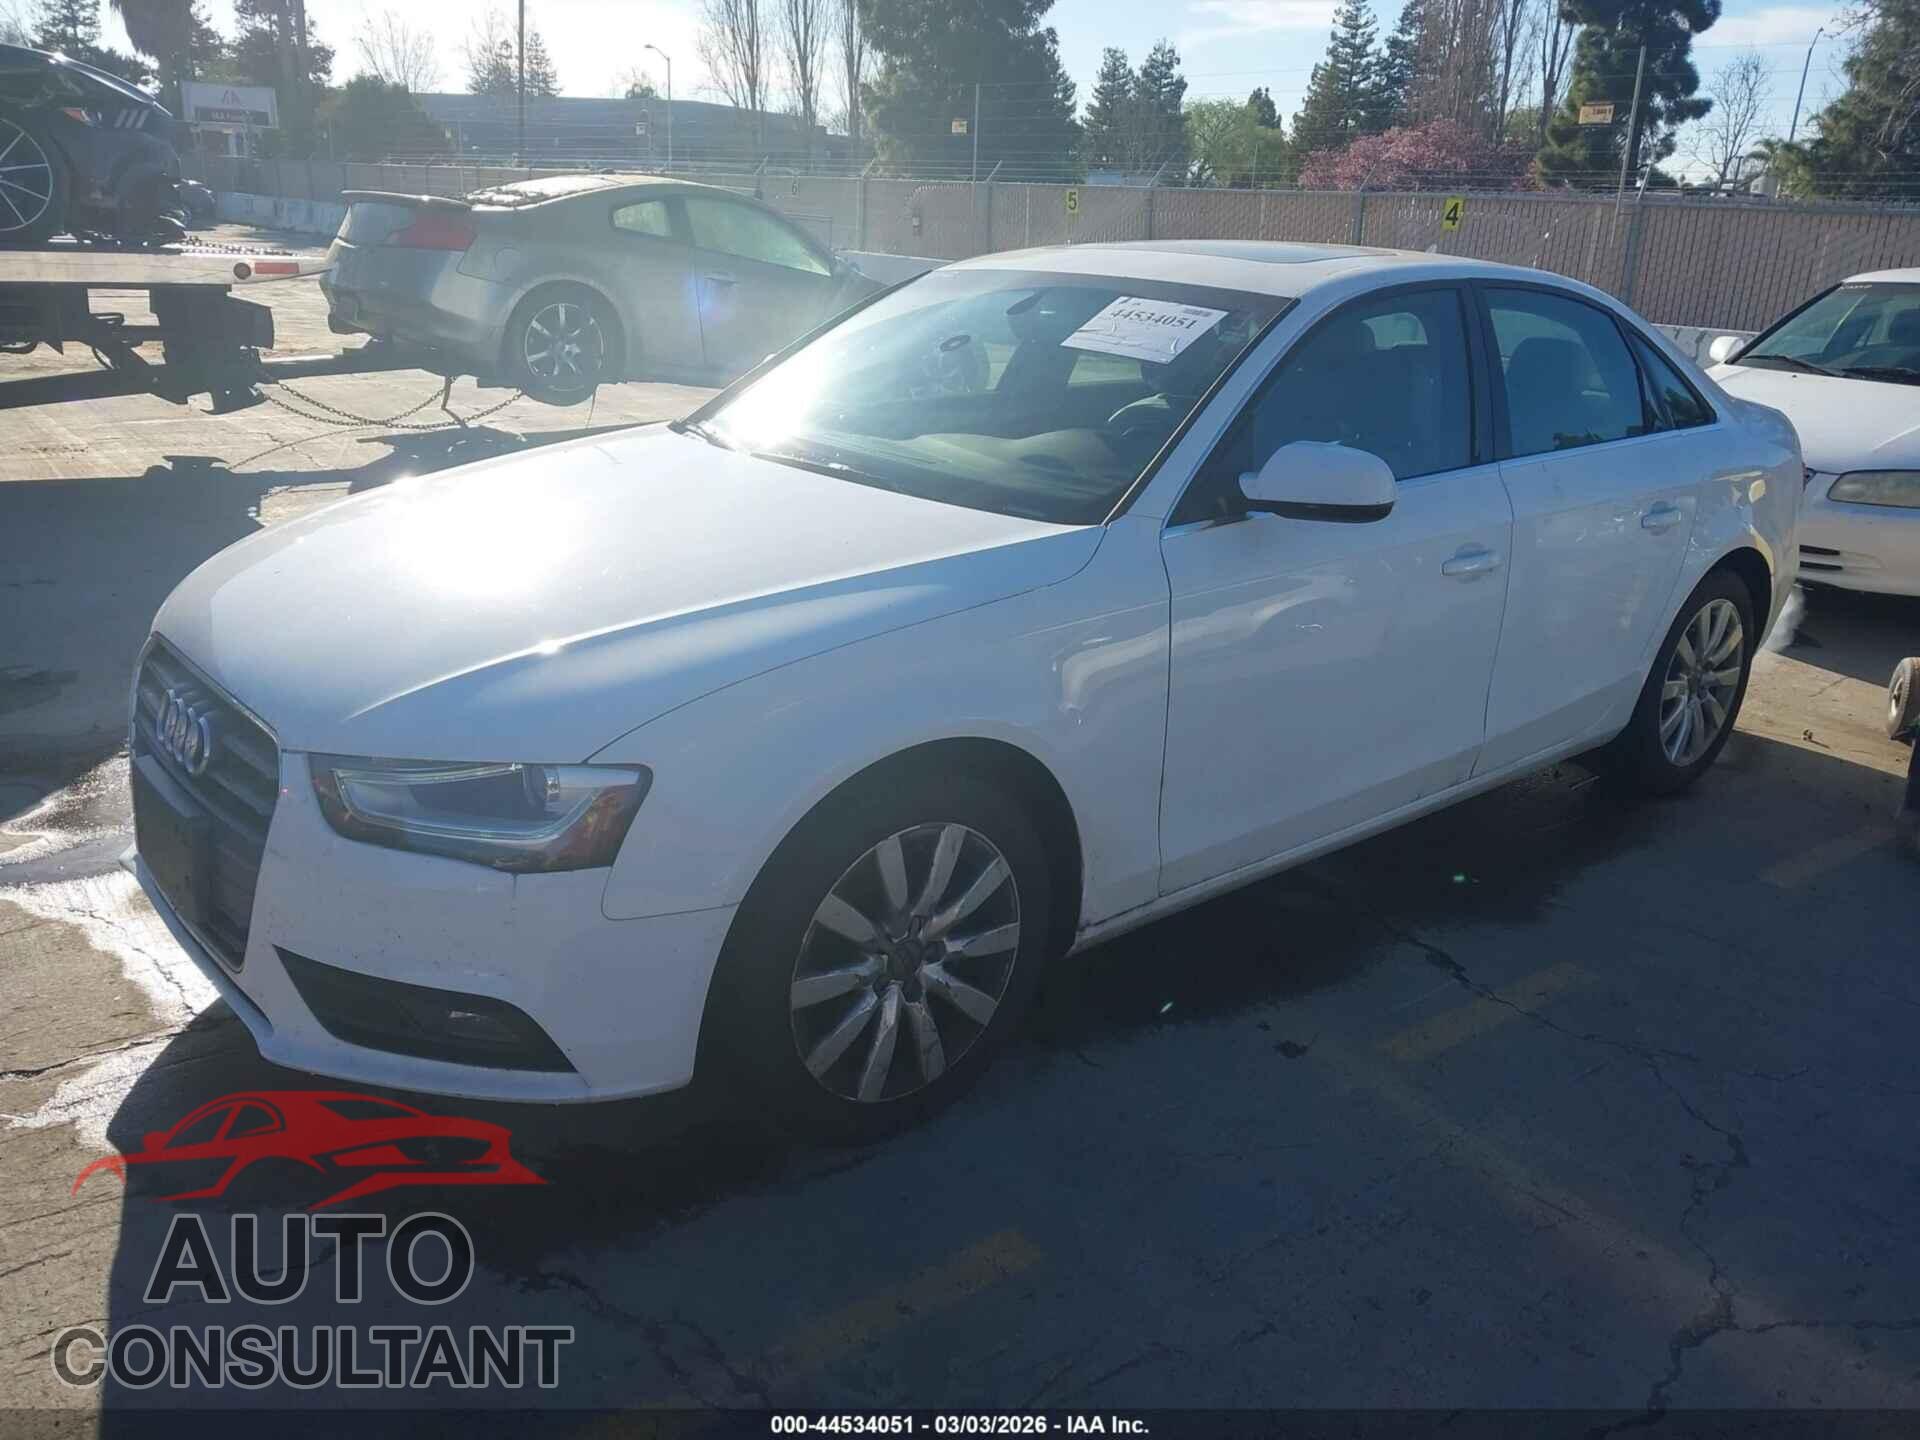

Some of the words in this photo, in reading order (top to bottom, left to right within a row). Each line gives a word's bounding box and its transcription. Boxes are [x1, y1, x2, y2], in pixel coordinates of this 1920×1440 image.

[1068, 190, 1078, 210] 5
[1445, 202, 1459, 226] 4
[1110, 308, 1198, 330] 44534051
